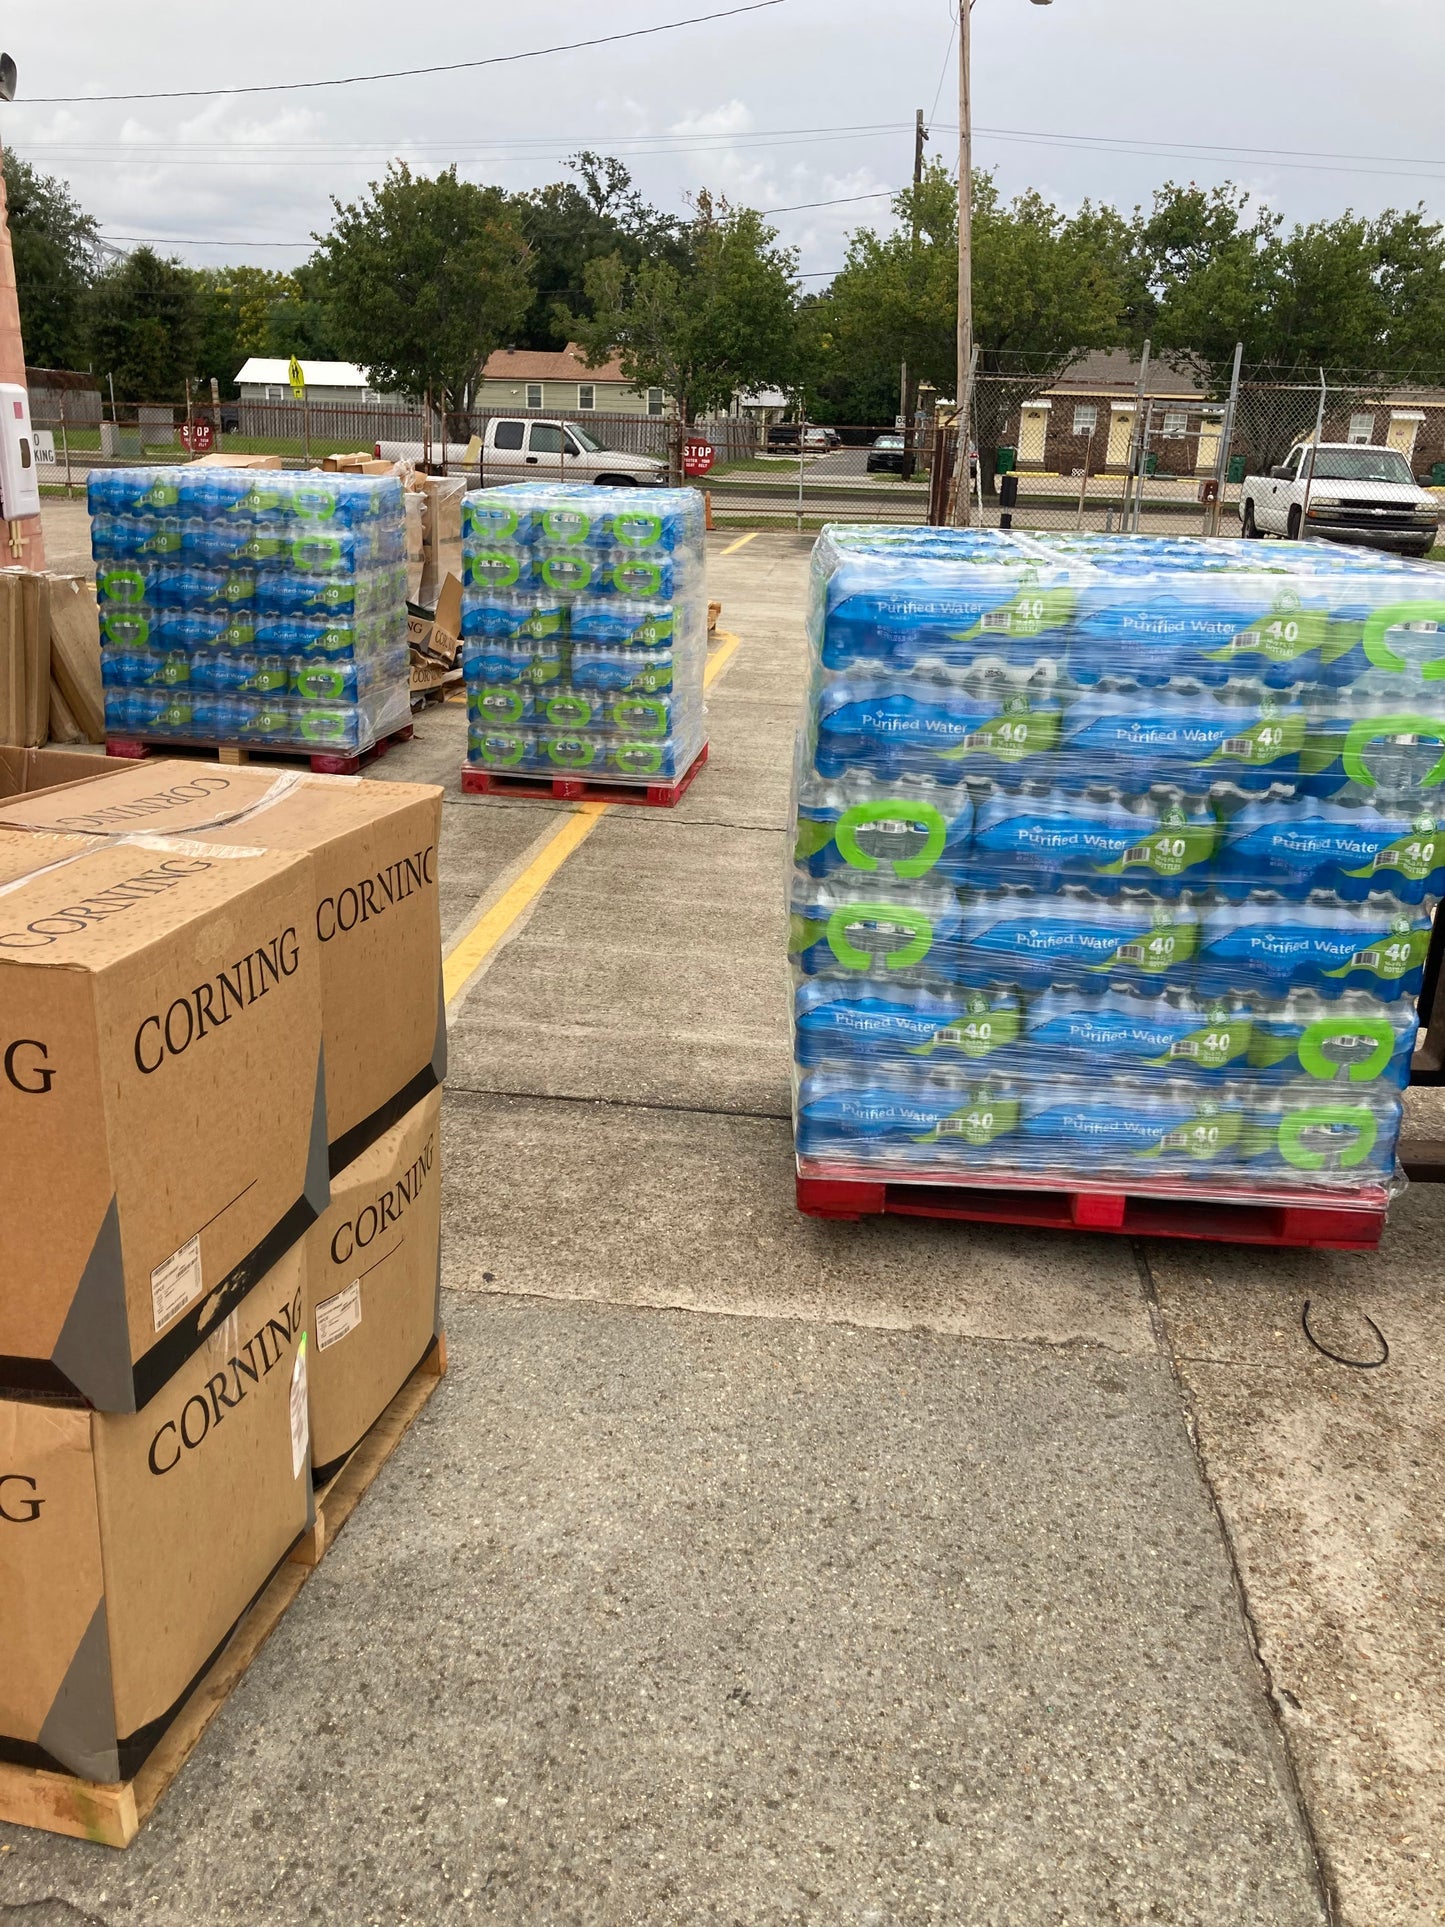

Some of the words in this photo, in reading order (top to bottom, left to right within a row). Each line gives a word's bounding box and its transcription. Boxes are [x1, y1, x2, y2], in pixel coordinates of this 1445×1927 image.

[684, 446, 712, 457] STOP
[877, 600, 934, 614] Purified
[941, 602, 982, 614] Water
[1015, 599, 1044, 620] 40
[1123, 617, 1185, 633] Purified
[1190, 620, 1237, 634] Water
[1265, 620, 1299, 641] 40
[862, 714, 920, 732] Purified
[925, 719, 968, 734] Water
[997, 722, 1028, 743] 40
[1116, 728, 1177, 743] Purified
[1182, 729, 1225, 743] Water
[1257, 727, 1283, 746] 40
[55, 777, 231, 828] CORNING
[1018, 829, 1079, 847] Purified
[1083, 833, 1127, 850] Water
[1154, 838, 1186, 857] 40
[1272, 835, 1331, 852] Purified
[1335, 838, 1379, 853] Water
[1405, 842, 1435, 861] 40
[0, 859, 213, 948] CORNING
[1016, 933, 1075, 949] Purified
[1078, 935, 1120, 949] Water
[1148, 936, 1175, 955] 40
[1251, 937, 1309, 954] Purified
[1313, 940, 1356, 955] Water
[1384, 943, 1411, 961] 40
[134, 927, 300, 1074] CORNING
[835, 1013, 892, 1031] Purified
[895, 1017, 937, 1033] Water
[964, 1022, 992, 1040] 40
[1070, 1025, 1128, 1042] Purified
[1131, 1029, 1174, 1044] Water
[1202, 1033, 1231, 1051] 40
[4, 1039, 57, 1094] G
[842, 1103, 895, 1120] Purified
[900, 1108, 938, 1122] Water
[967, 1111, 993, 1129] 40
[1063, 1116, 1119, 1134] Purified
[1123, 1122, 1164, 1137] Water
[1192, 1126, 1220, 1143] 40
[330, 1132, 435, 1265] CORNING
[148, 1286, 302, 1476] CORNING
